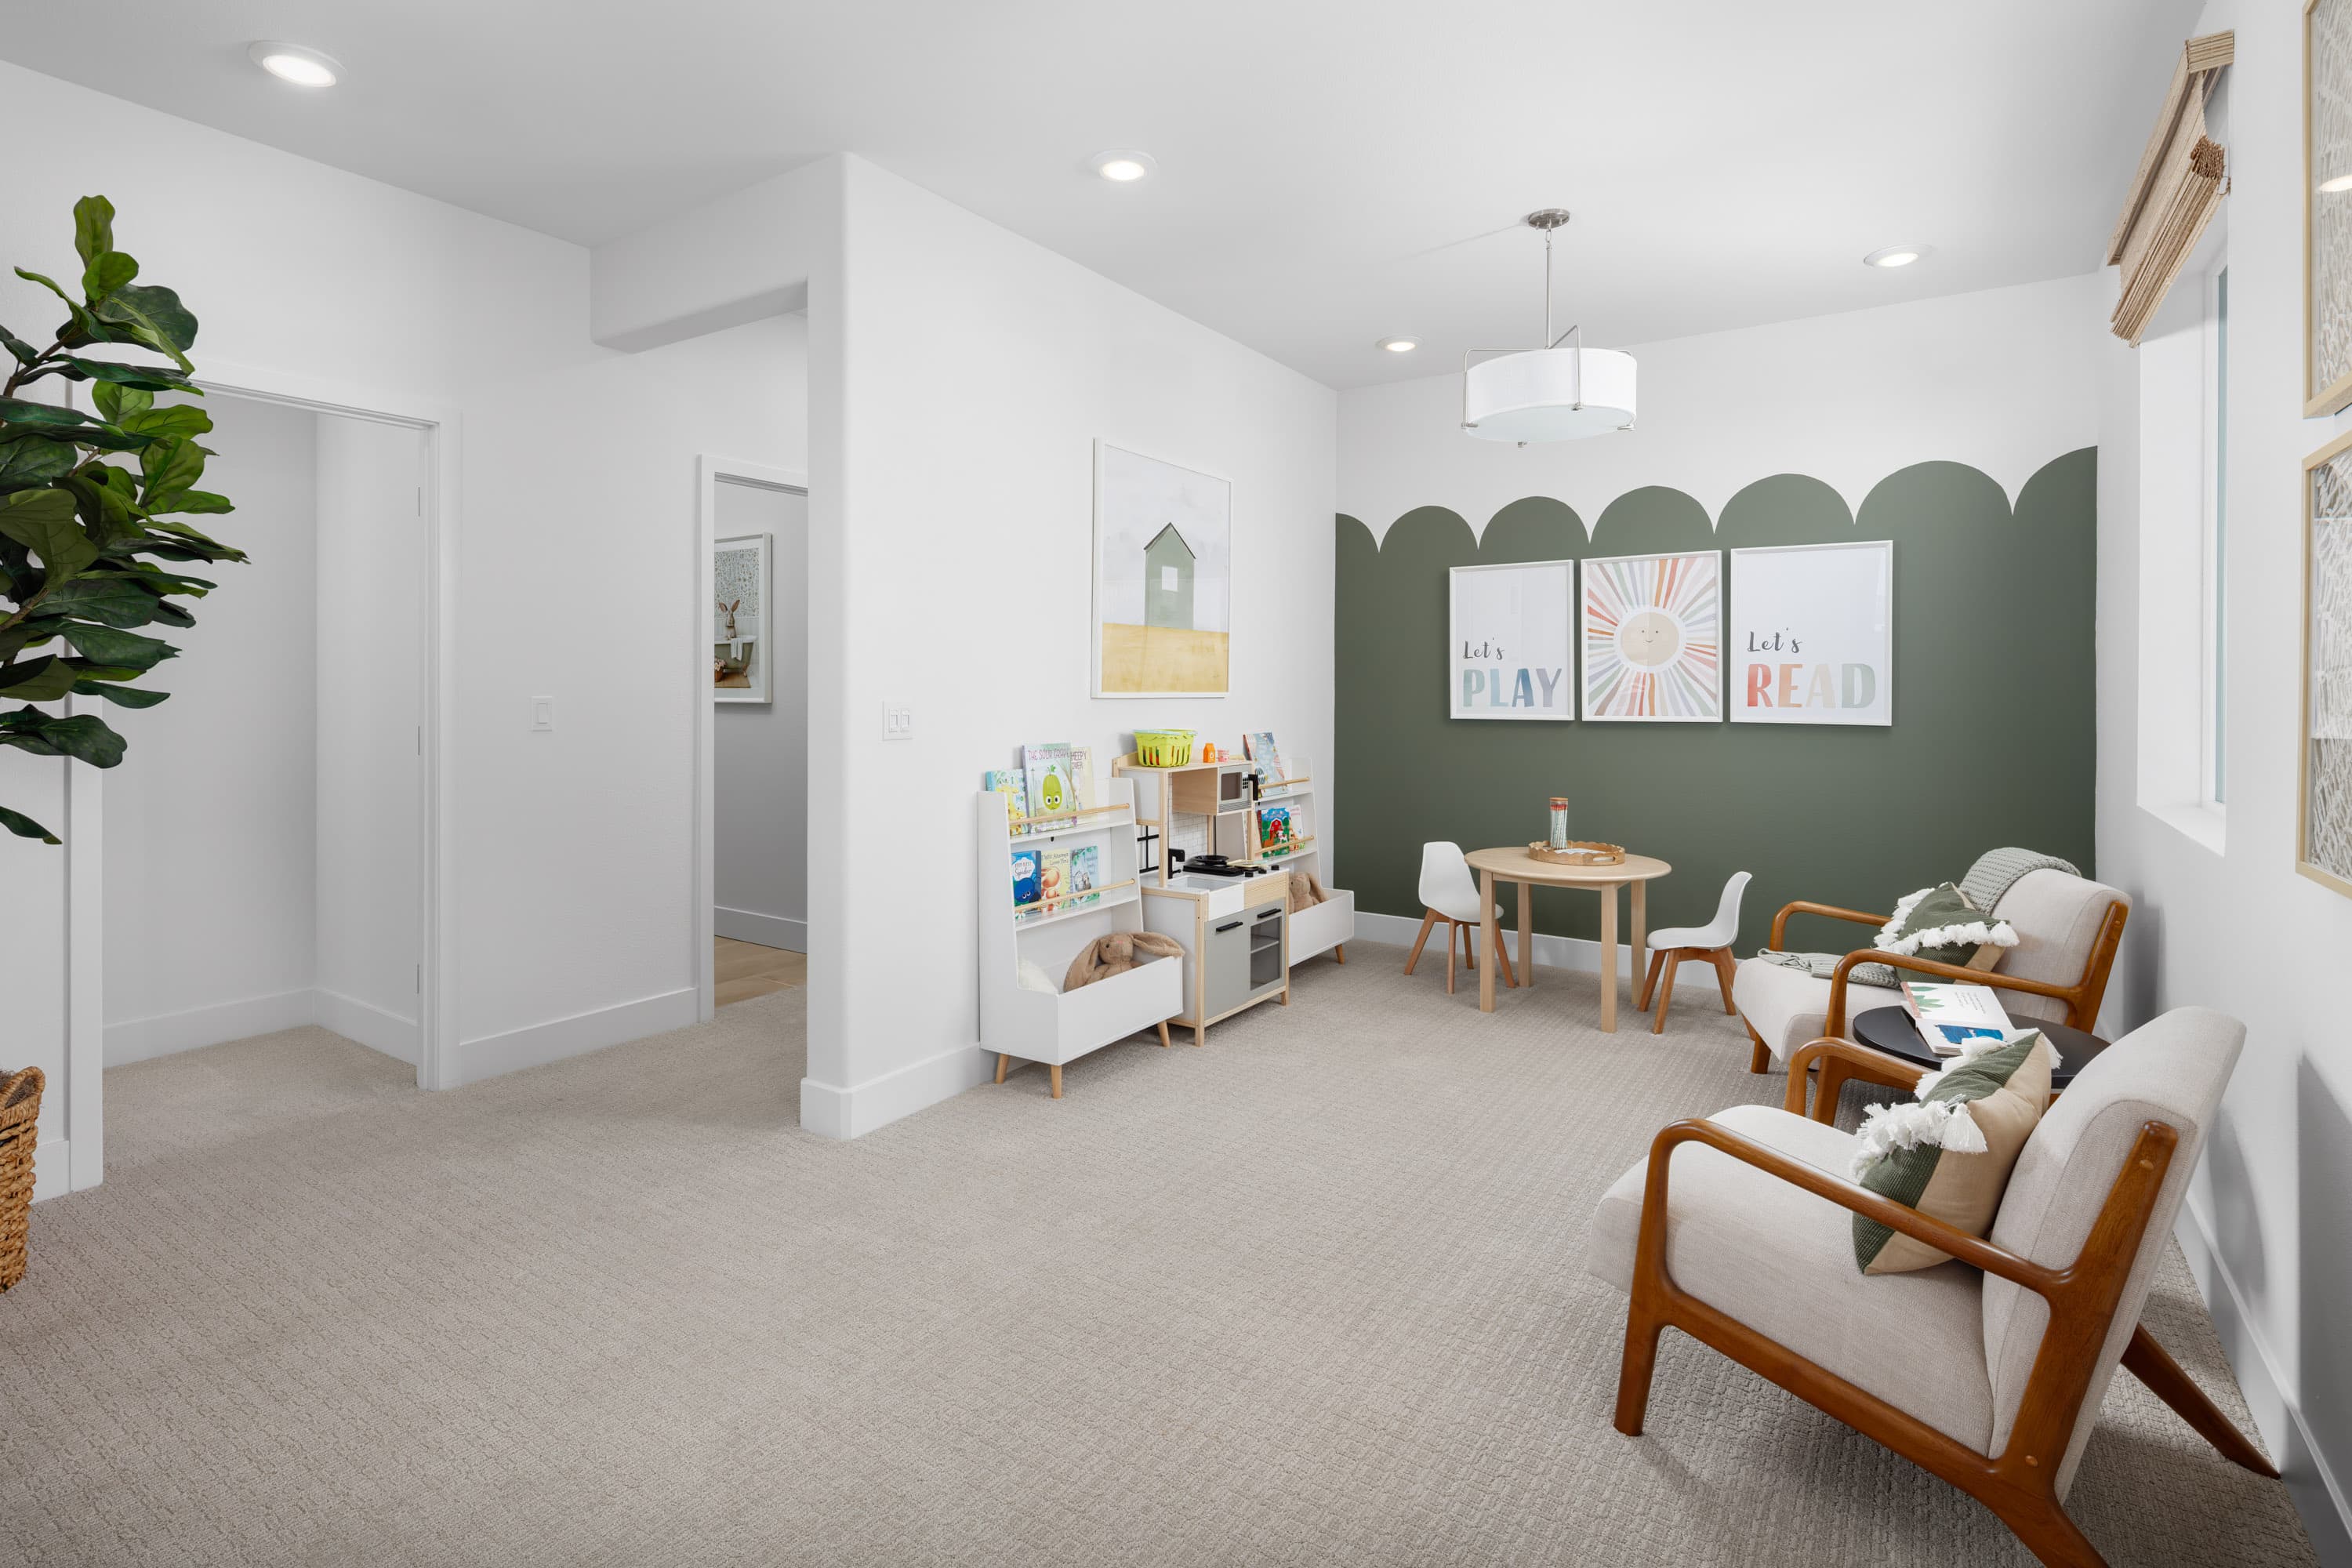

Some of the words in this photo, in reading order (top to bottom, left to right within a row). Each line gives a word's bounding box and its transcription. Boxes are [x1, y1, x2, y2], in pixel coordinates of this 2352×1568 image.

[1463, 637, 1504, 660] Let's
[1747, 627, 1802, 653] Let's
[1463, 668, 1562, 707] PLAY
[1747, 663, 1875, 708] READ
[1029, 750, 1038, 760] THE
[1039, 748, 1052, 760] SOUR
[1015, 866, 1032, 878] Spider
